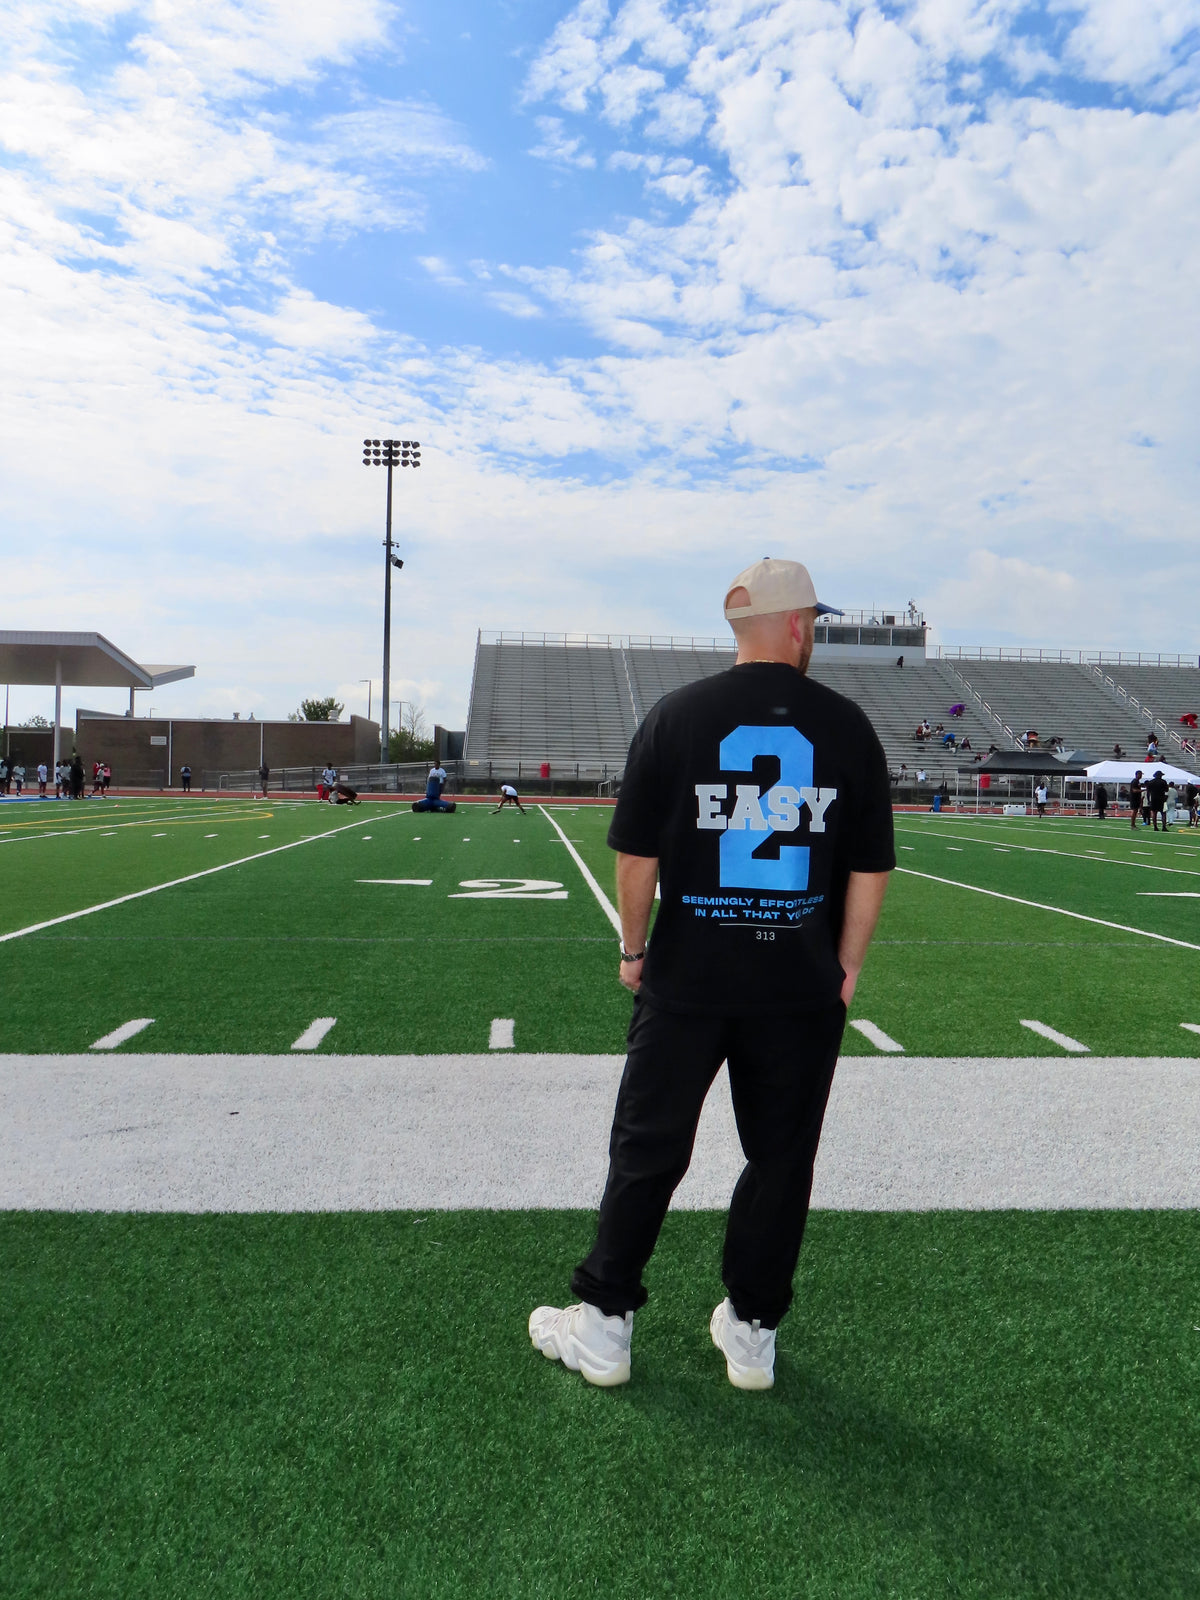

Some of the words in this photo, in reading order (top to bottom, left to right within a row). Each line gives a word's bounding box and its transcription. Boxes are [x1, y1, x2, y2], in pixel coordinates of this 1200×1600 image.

[695, 784, 838, 833] EASY
[719, 725, 814, 892] 2
[448, 878, 569, 899] 2
[682, 895, 754, 906] SEEMINGLY
[695, 908, 707, 917] IN
[711, 909, 738, 918] ALL
[743, 910, 781, 920] THAT
[755, 931, 776, 941] 313
